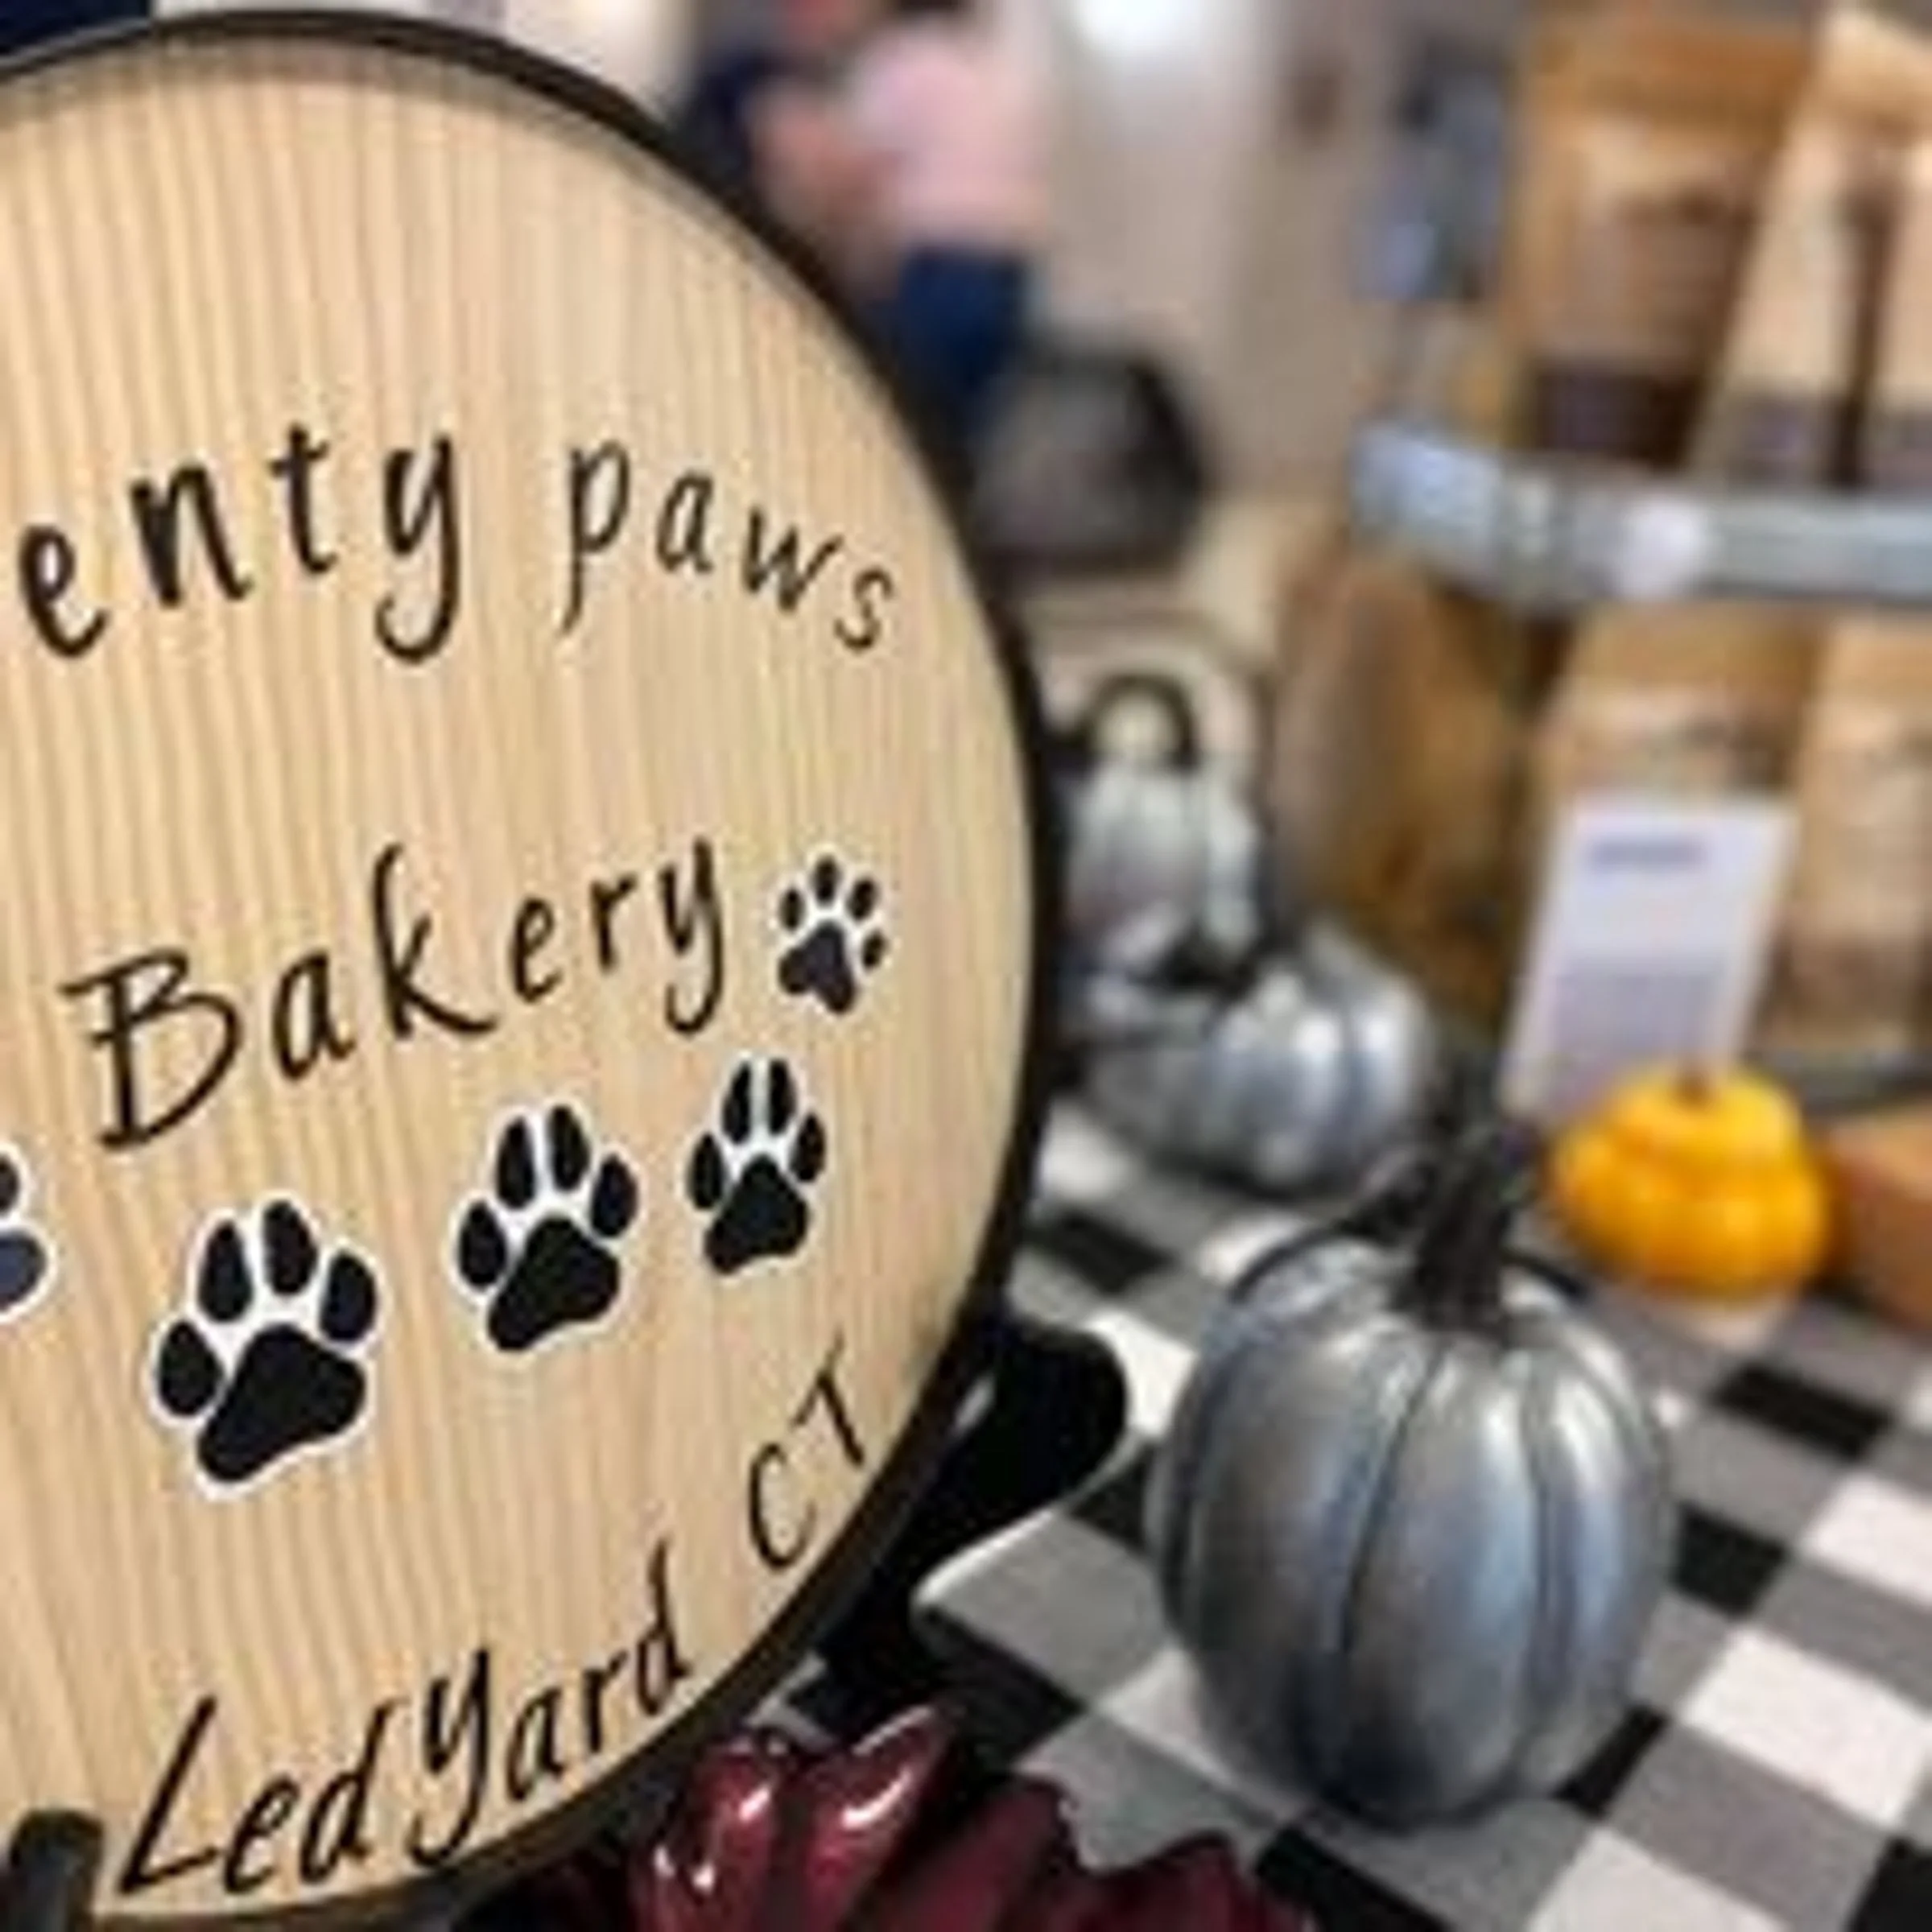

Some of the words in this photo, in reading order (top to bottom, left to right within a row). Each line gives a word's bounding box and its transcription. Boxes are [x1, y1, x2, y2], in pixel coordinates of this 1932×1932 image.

[563, 440, 894, 654] paws
[60, 838, 727, 1153] Bakery
[745, 1337, 869, 1575] CT
